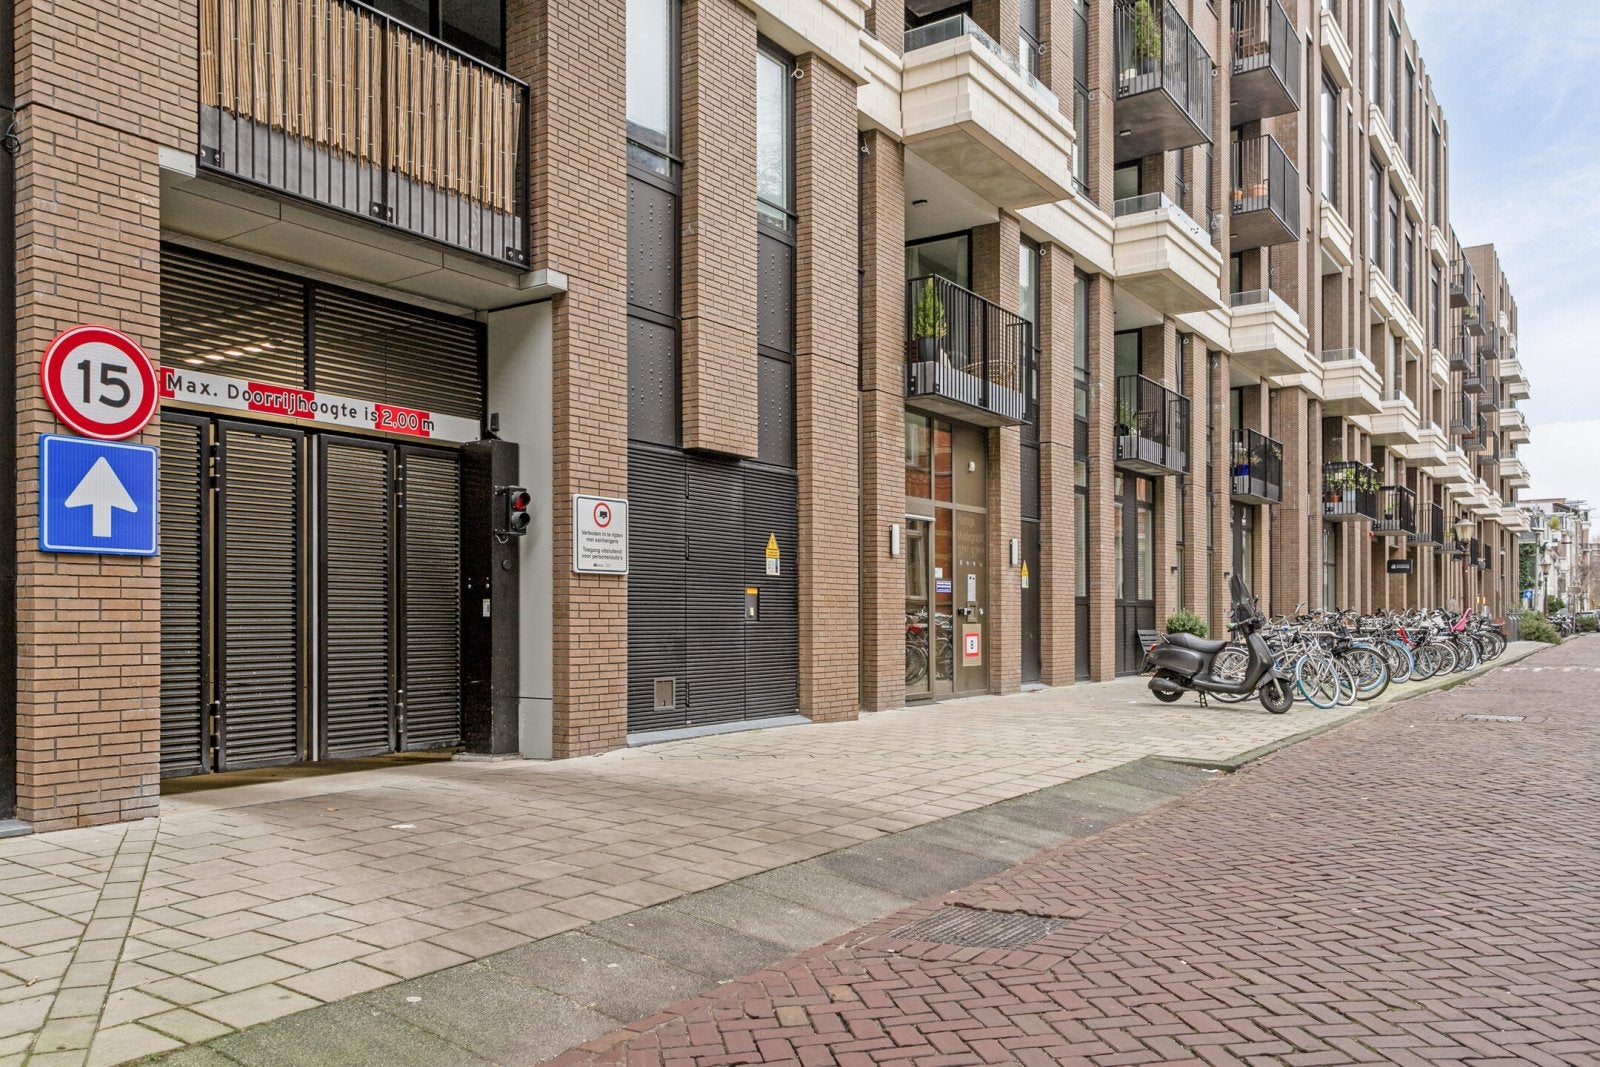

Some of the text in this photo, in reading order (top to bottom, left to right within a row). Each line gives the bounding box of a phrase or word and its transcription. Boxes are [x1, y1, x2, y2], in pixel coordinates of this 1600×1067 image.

[77, 359, 131, 408] 15
[167, 373, 218, 397] Max.
[227, 383, 358, 419] Doorrijhoogte
[364, 406, 378, 421] is
[422, 419, 435, 431] m
